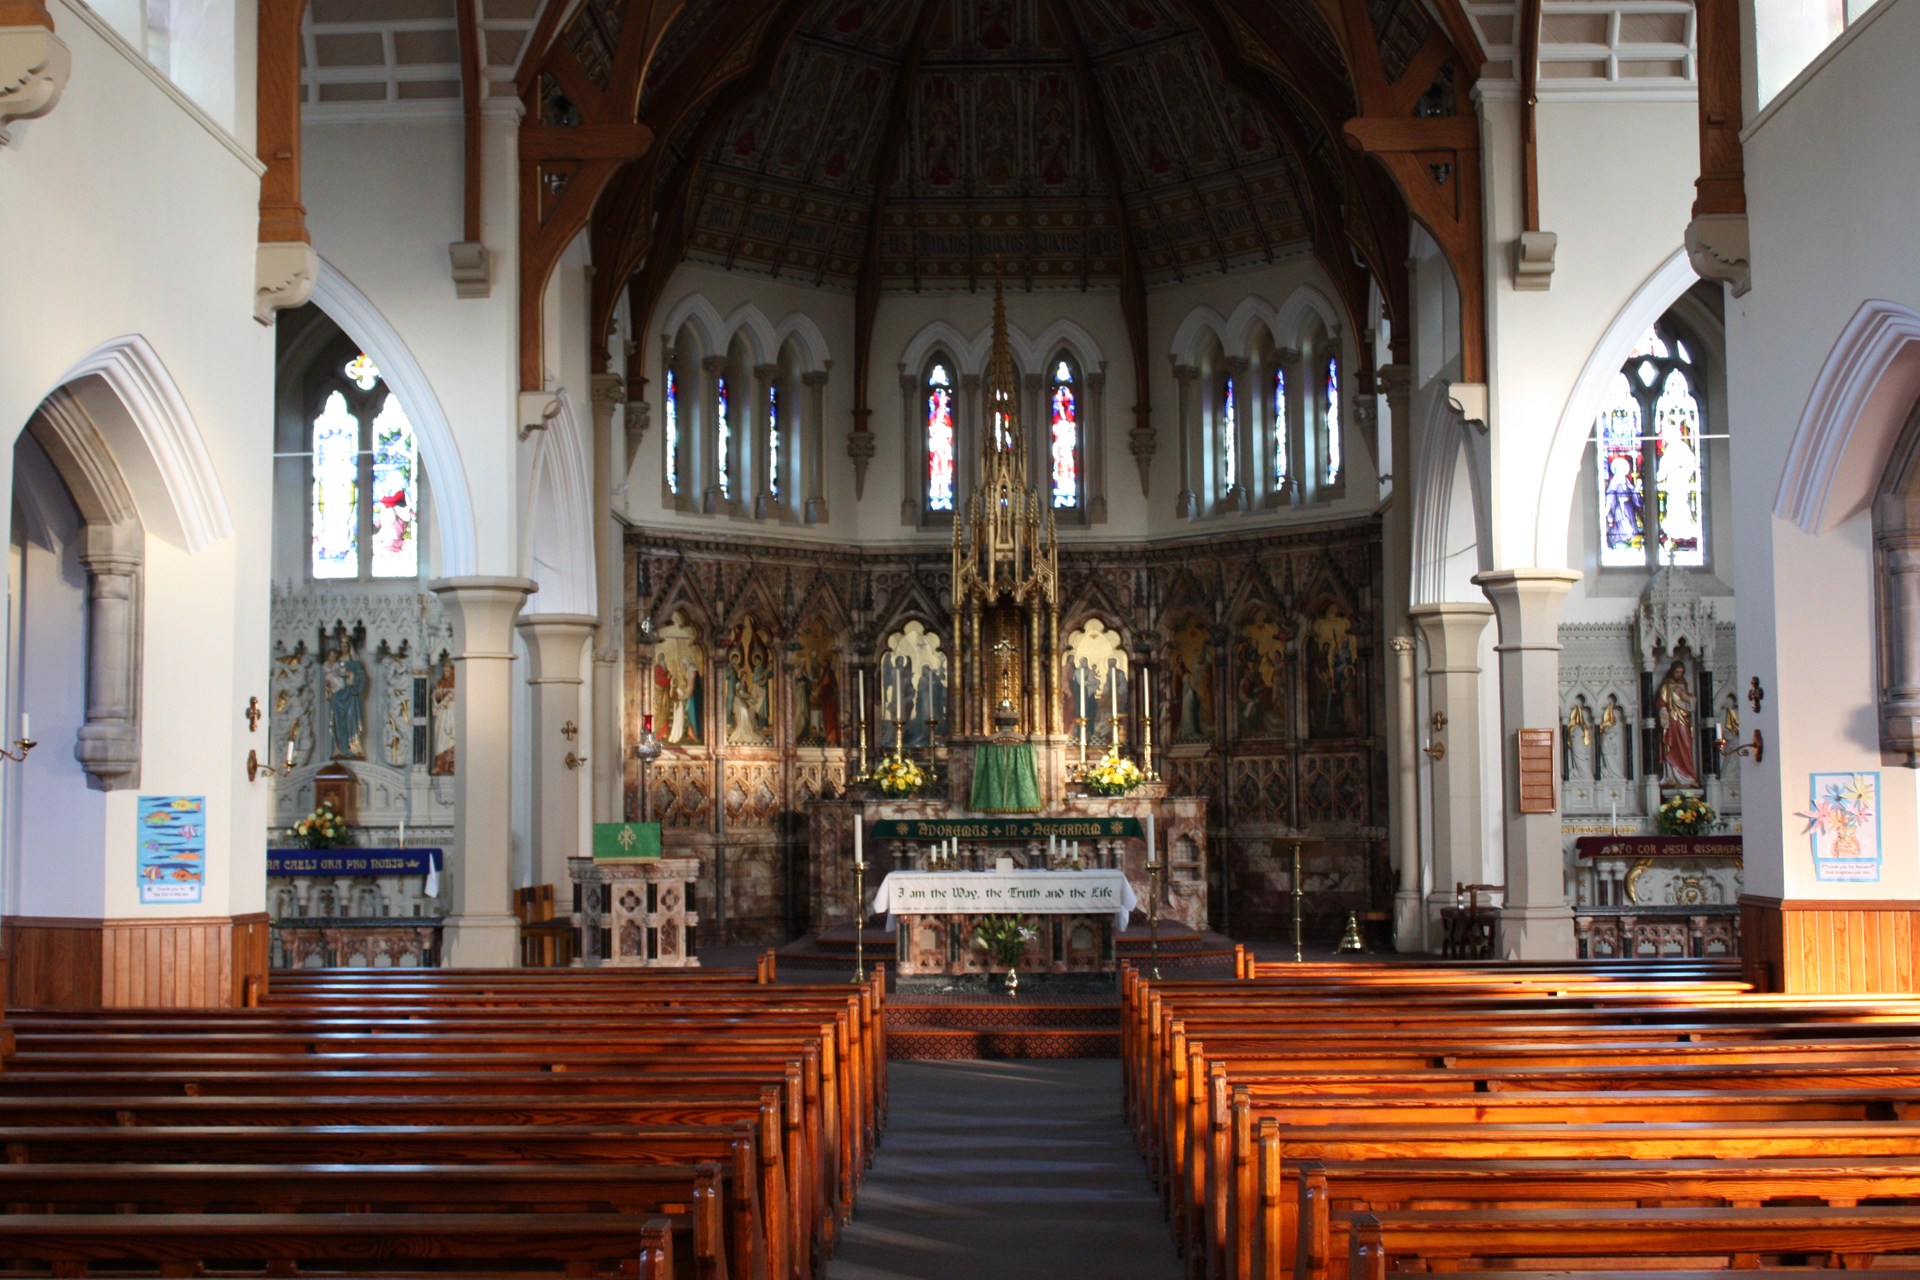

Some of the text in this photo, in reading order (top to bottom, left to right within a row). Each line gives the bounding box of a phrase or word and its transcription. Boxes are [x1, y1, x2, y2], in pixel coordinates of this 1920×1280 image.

[918, 822, 988, 836] ADOREMUS
[1032, 822, 1101, 836] AETERNUM
[1637, 844, 1656, 854] COR
[320, 859, 343, 870] ORA
[346, 859, 367, 870] PRO
[898, 888, 905, 899] I
[910, 890, 926, 899] am
[931, 888, 947, 900] the
[986, 888, 1002, 899] the
[1008, 887, 1041, 899] Truth
[1045, 888, 1065, 899] and
[1070, 888, 1086, 899] the
[1091, 887, 1113, 899] Life
